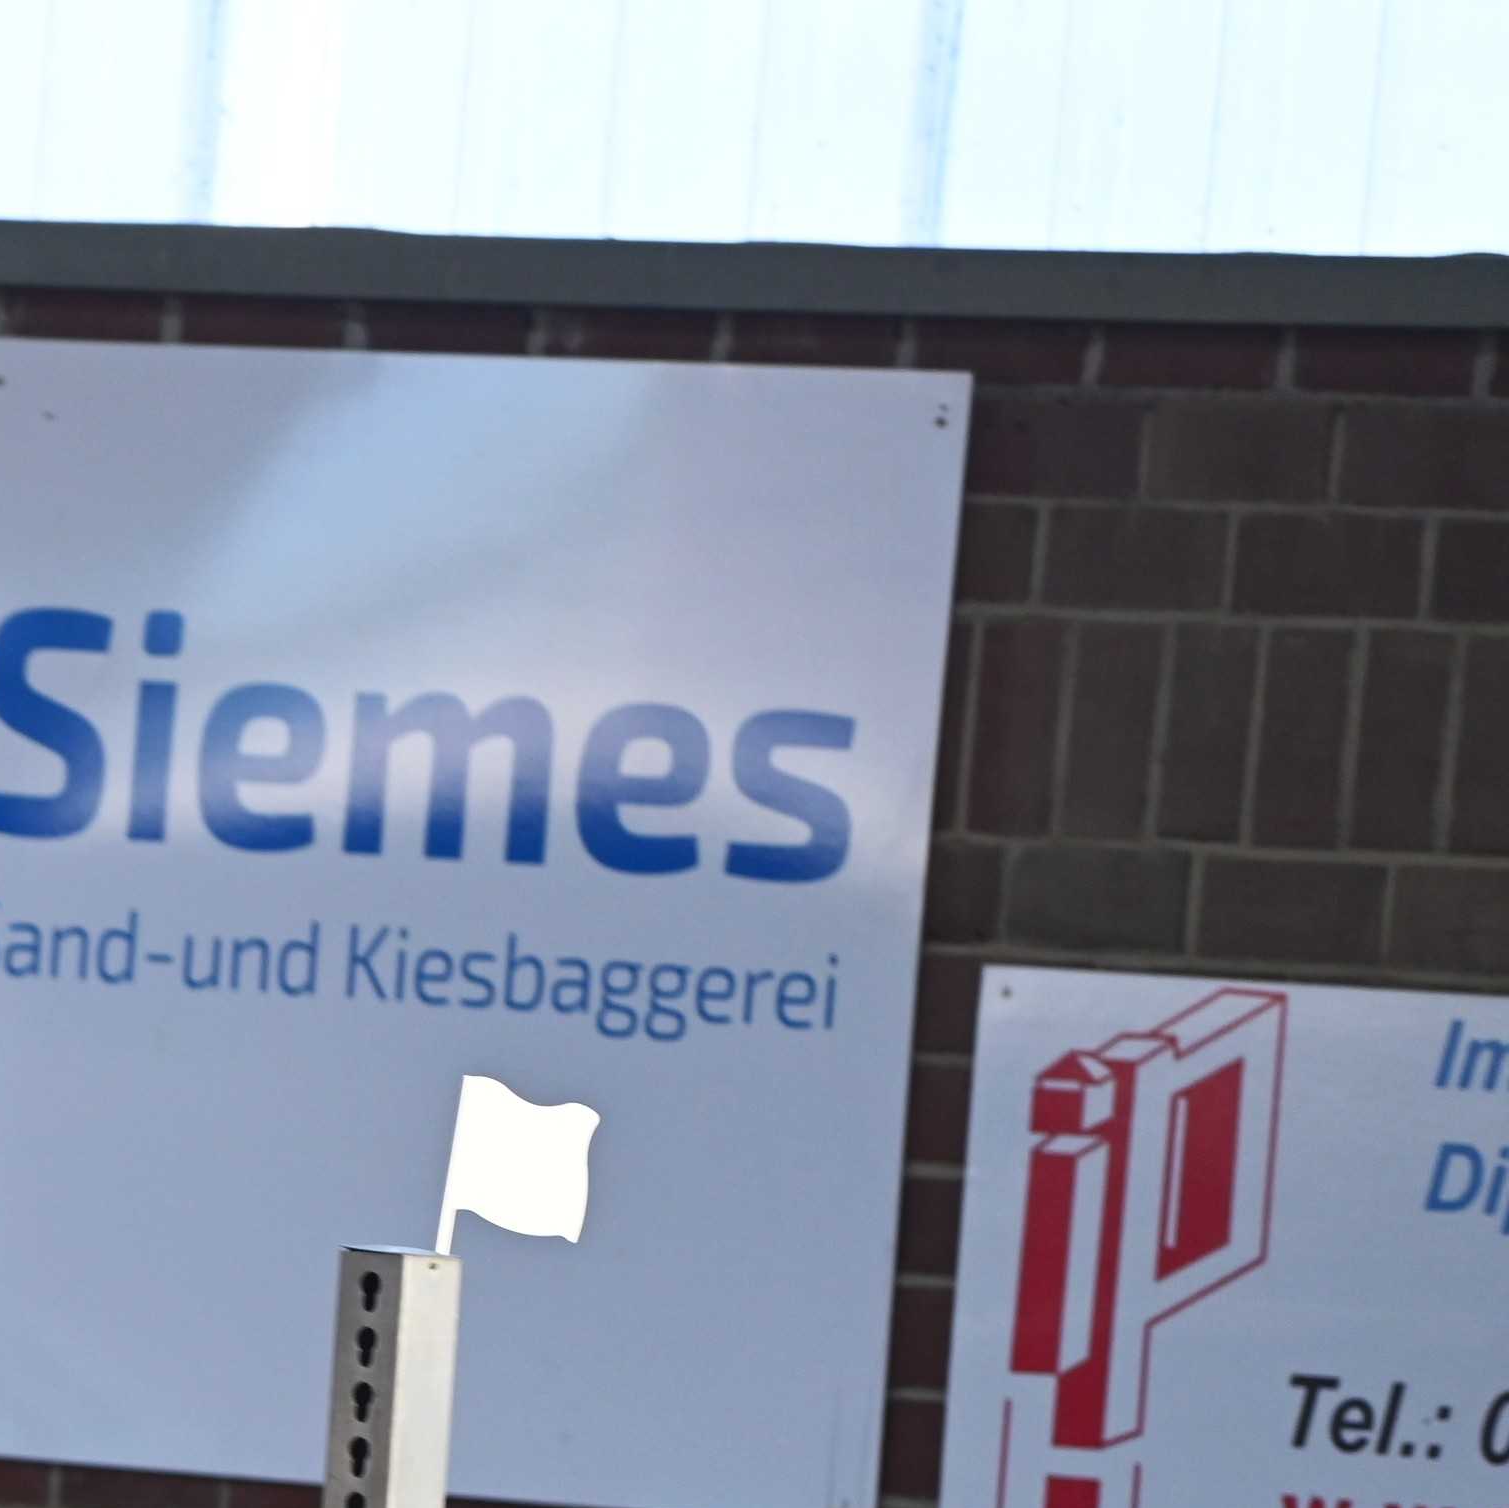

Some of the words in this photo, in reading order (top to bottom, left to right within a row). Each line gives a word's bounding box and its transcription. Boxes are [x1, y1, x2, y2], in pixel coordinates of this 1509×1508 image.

[344, 924, 841, 1042] Kiesbaggerei
[1423, 1140, 1509, 1237] Di
[1288, 1372, 1453, 1462] Tel.:
